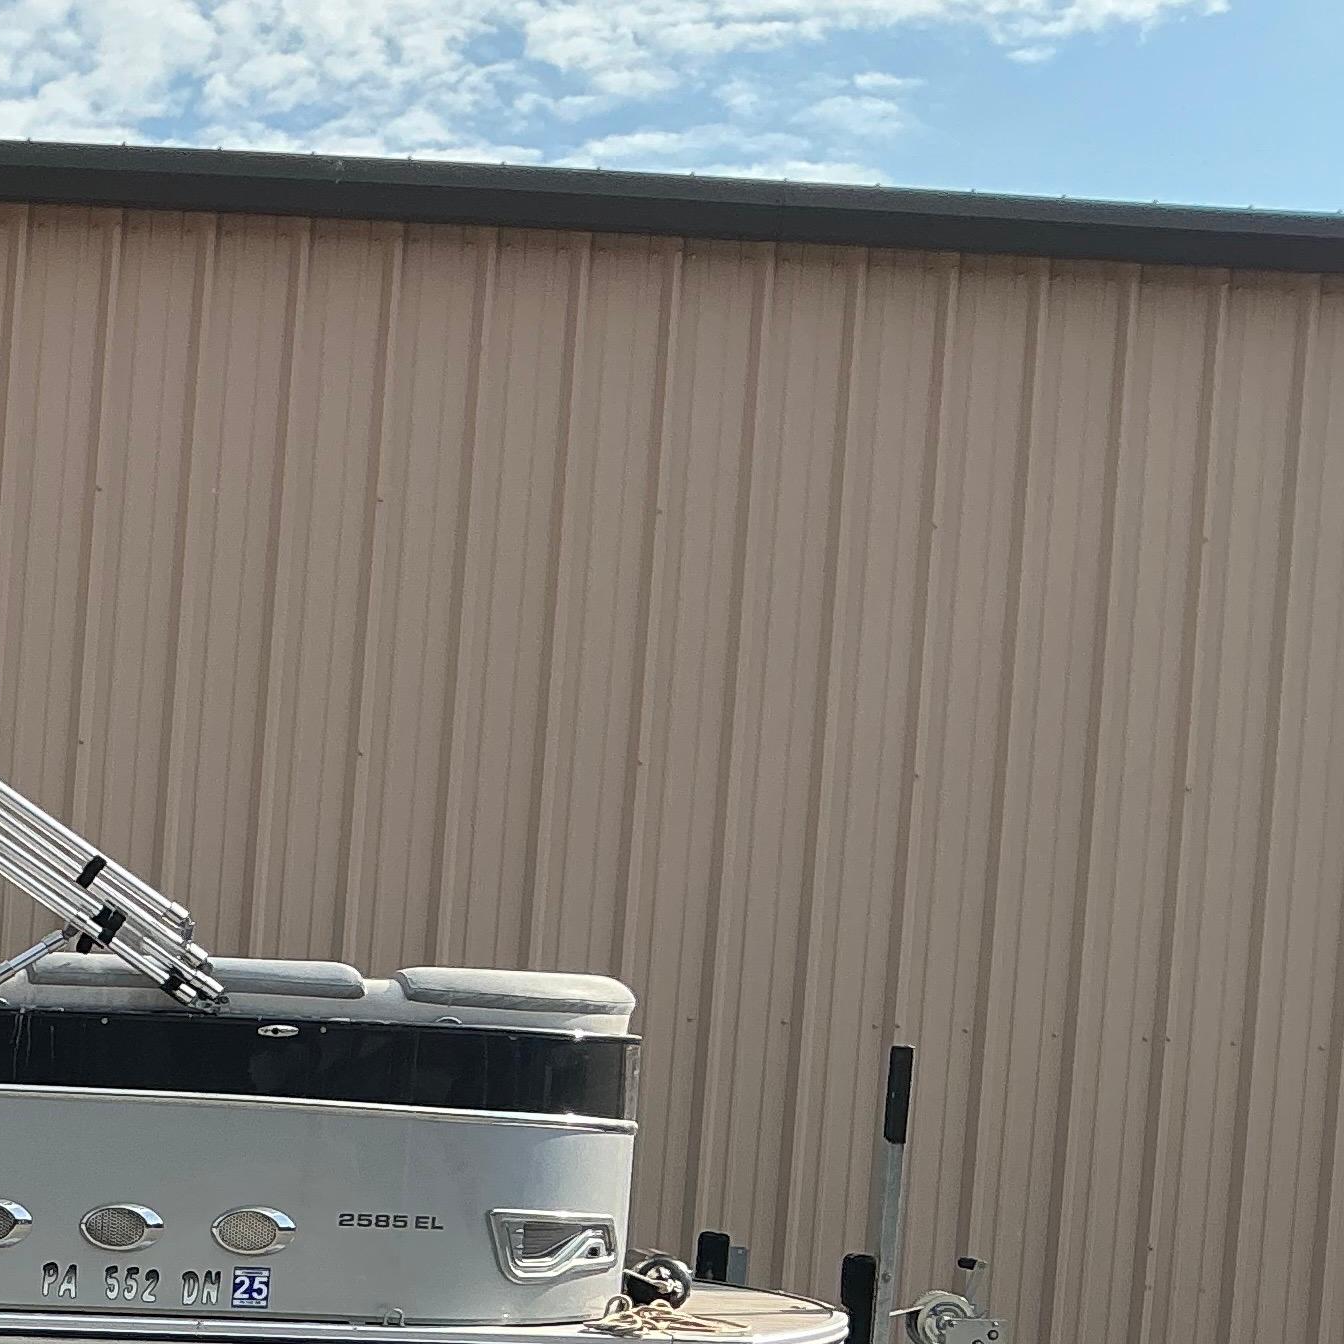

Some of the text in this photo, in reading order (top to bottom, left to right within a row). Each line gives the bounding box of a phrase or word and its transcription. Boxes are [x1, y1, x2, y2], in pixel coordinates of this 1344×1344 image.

[338, 1213, 444, 1230] 2585 EL
[41, 1261, 222, 1305] PA 552 DN
[233, 1276, 269, 1300] 25
